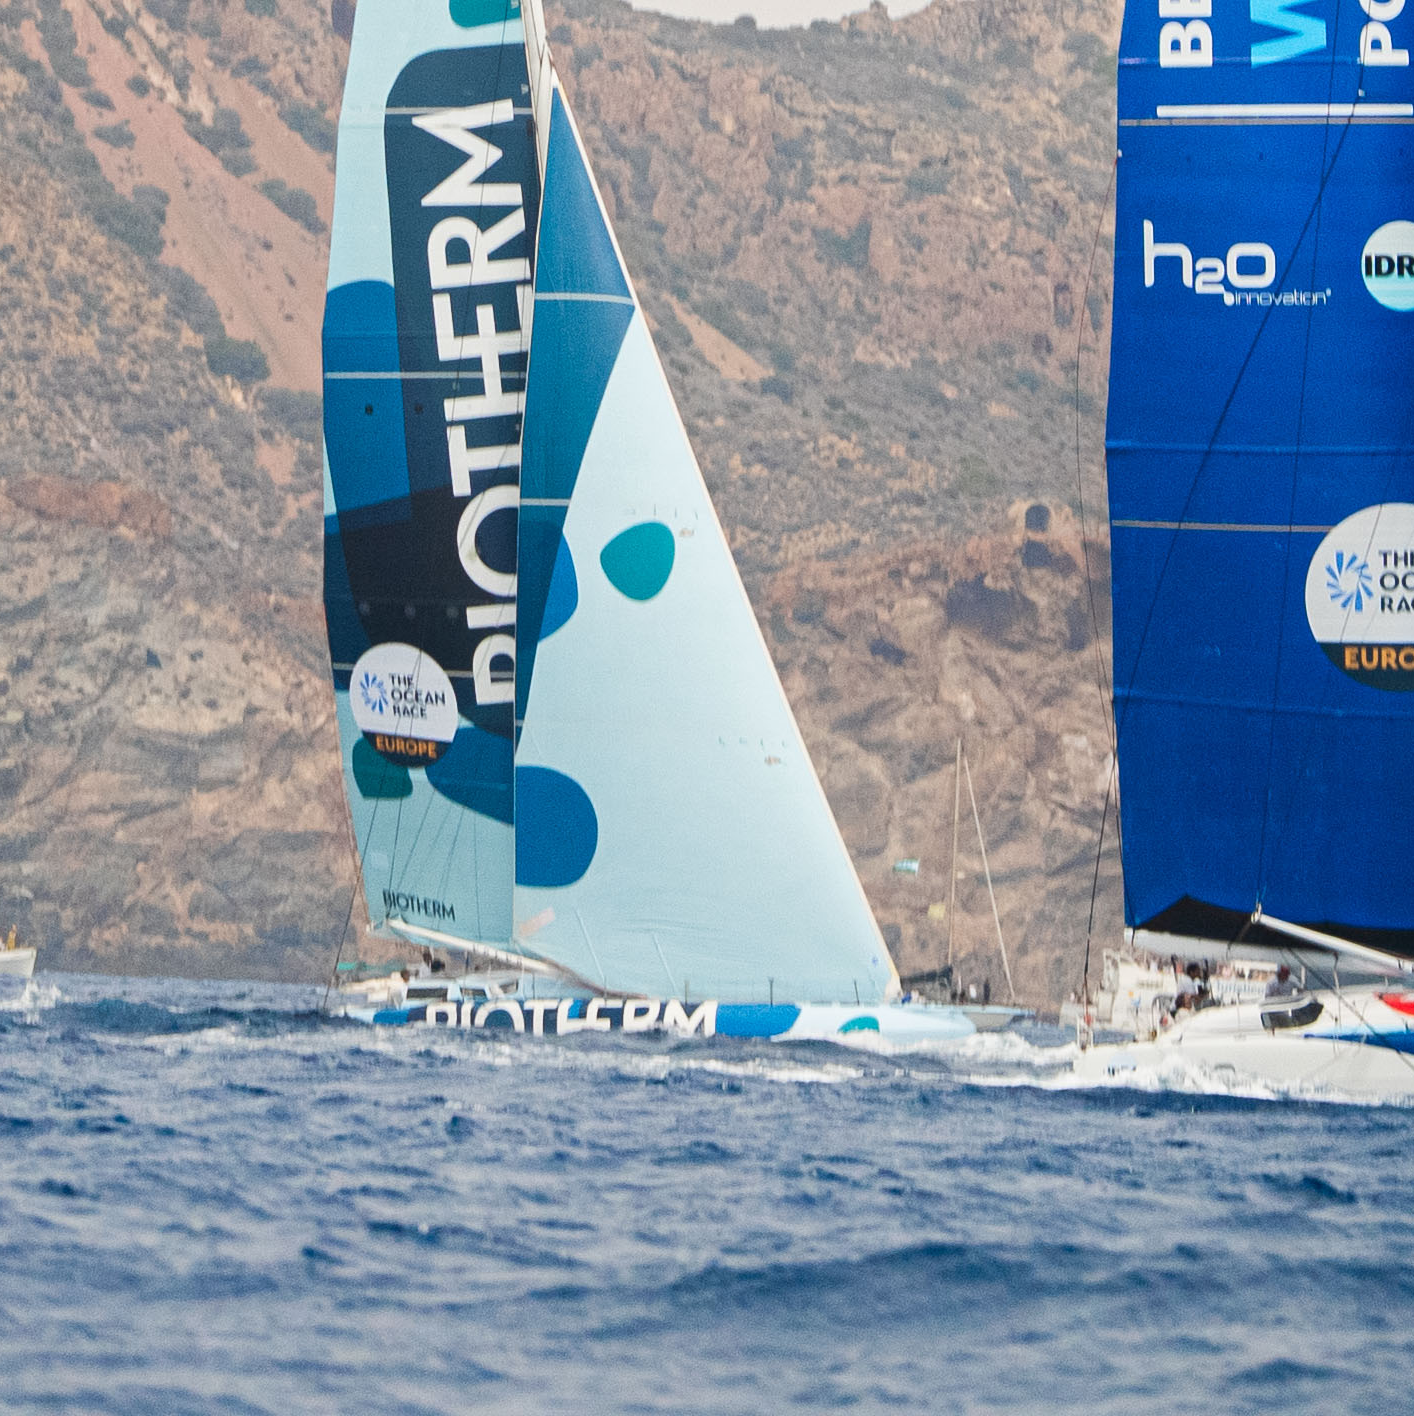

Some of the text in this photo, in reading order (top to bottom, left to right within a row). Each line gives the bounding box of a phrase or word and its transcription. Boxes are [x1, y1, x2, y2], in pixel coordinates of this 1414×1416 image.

[1235, 288, 1328, 306] innovation
[388, 672, 413, 686] THE
[390, 689, 446, 706] OCEAN
[393, 705, 427, 719] RACE
[375, 735, 437, 759] EUROPE
[382, 888, 456, 922] BIOTHERM
